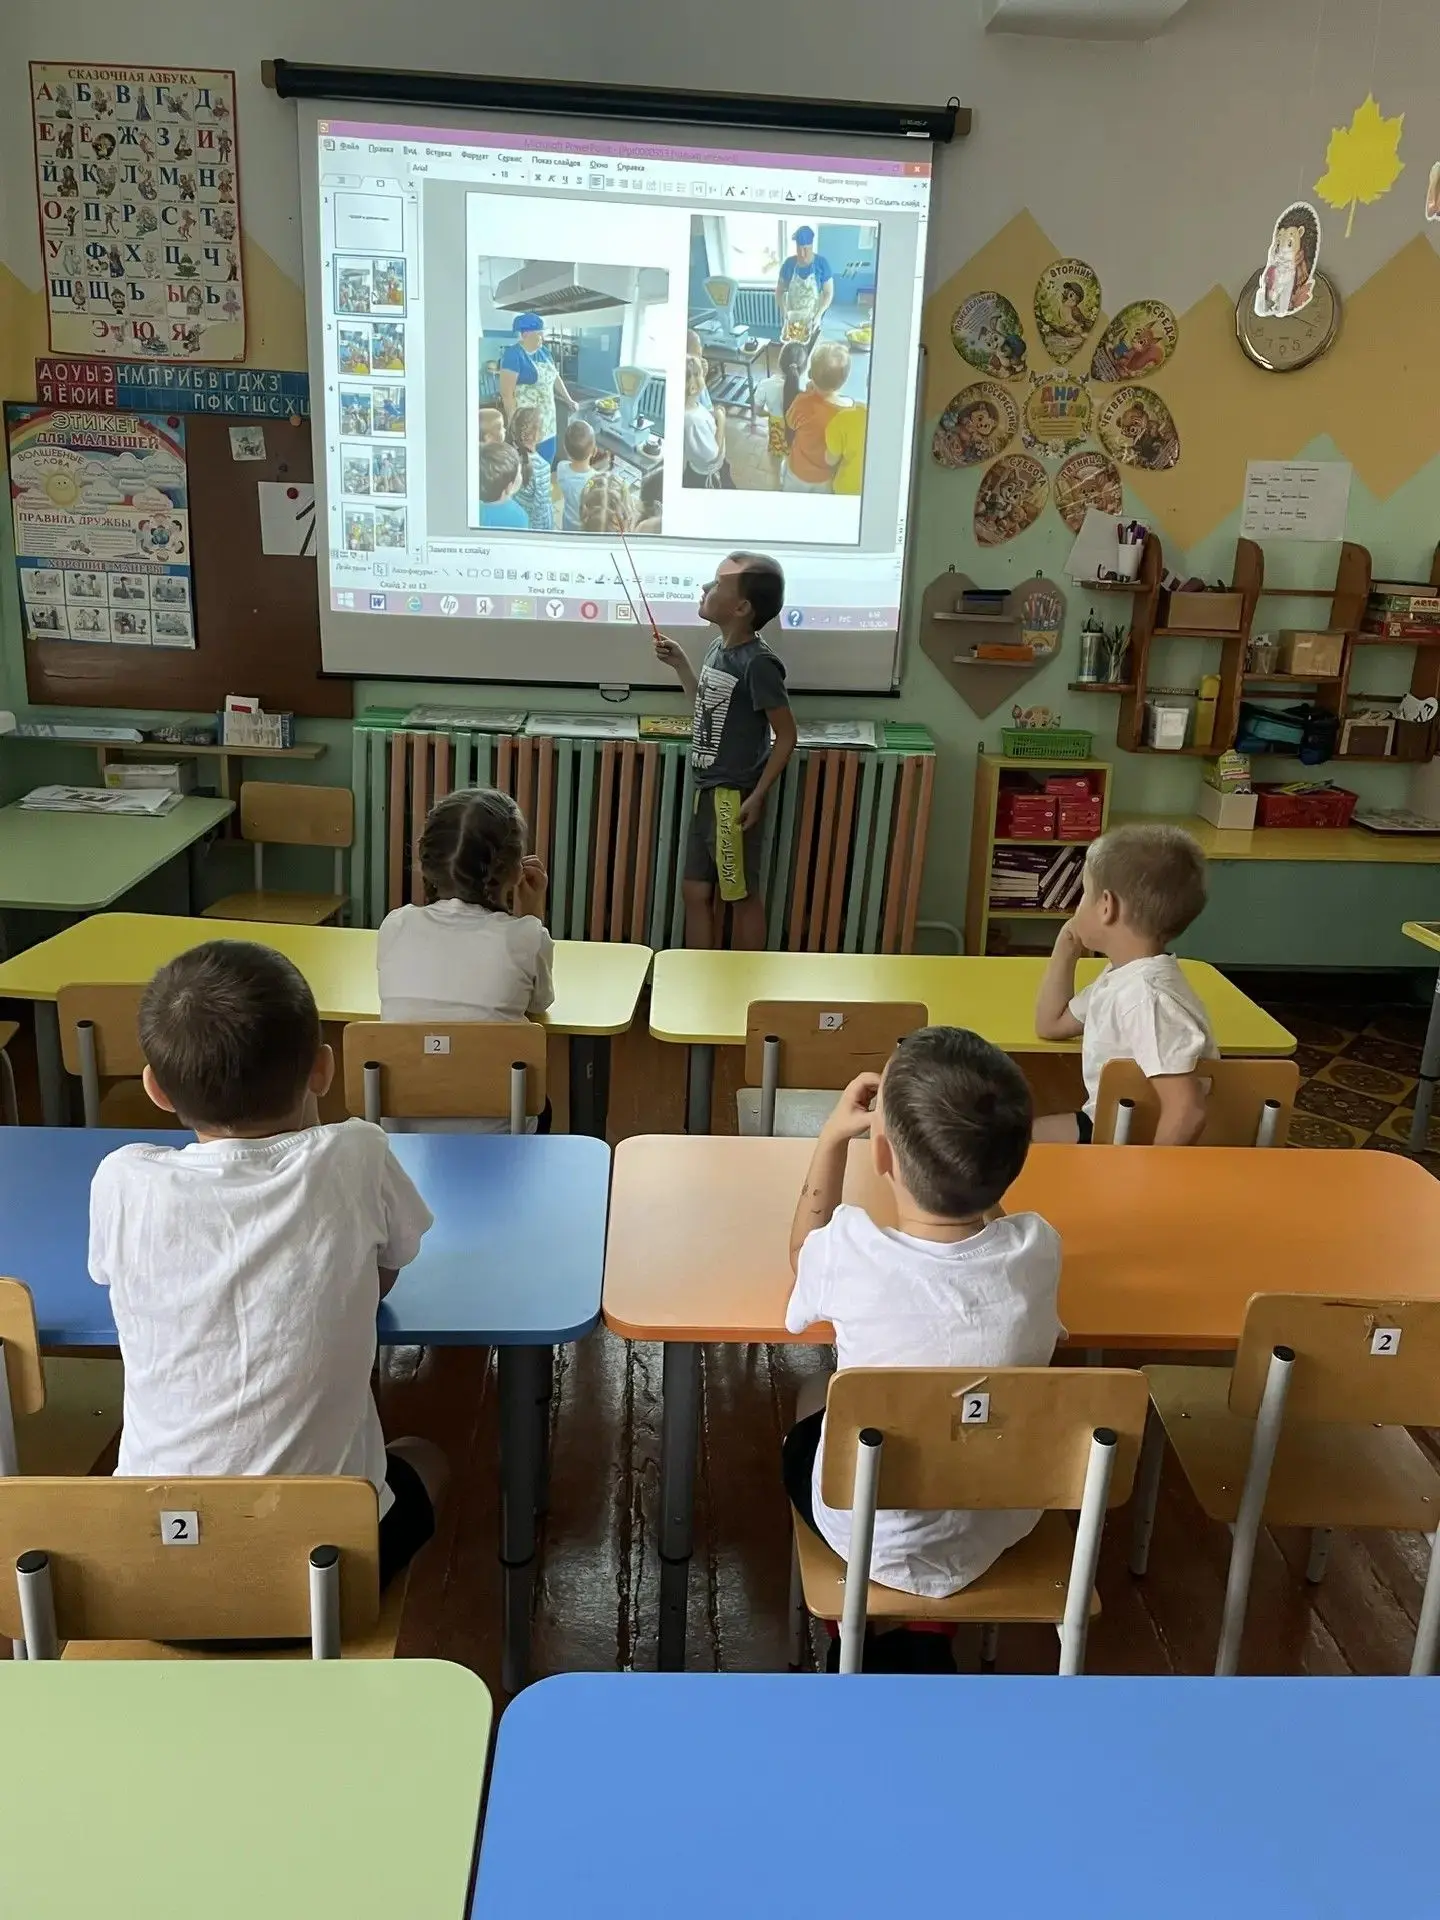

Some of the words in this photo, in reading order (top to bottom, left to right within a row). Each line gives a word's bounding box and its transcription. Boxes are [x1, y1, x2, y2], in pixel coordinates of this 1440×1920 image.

[68, 69, 145, 82] СКАЗОЧНАЯ
[148, 73, 197, 85] АЗБУКА
[37, 84, 53, 101] А
[77, 83, 91, 102] Б
[116, 85, 131, 103] В
[155, 86, 170, 105] Г
[195, 88, 212, 111] Д
[38, 123, 55, 141] Е
[79, 122, 93, 142] Ё
[118, 126, 139, 145] Ж
[157, 127, 170, 146] З
[197, 129, 215, 148] И
[41, 160, 59, 182] Й
[81, 164, 98, 183] К
[120, 165, 137, 184] Л
[159, 167, 179, 185] М
[199, 168, 216, 187] Н
[412, 164, 428, 172] Arial
[44, 201, 62, 219] О
[83, 203, 101, 221] П
[122, 204, 136, 222] Р
[161, 206, 178, 225] С
[200, 208, 216, 227] Т
[47, 240, 63, 258] У
[86, 242, 106, 260] Ф
[125, 244, 142, 262] Х
[165, 245, 181, 265] Ц
[203, 248, 220, 266] Ч
[1050, 265, 1092, 279] ВТОРНИК
[50, 280, 72, 298] Ш
[89, 281, 111, 303] Щ
[126, 283, 145, 301] Ъ
[167, 284, 187, 303] Ы
[205, 285, 221, 304] Ь
[92, 320, 109, 338] Э
[132, 321, 155, 340] Ю
[171, 323, 188, 341] Я
[1153, 306, 1176, 343] СРЕДА
[1101, 389, 1134, 427] ЧЕТВЕРГ
[52, 412, 139, 433] ЭТИКЕТ
[37, 432, 66, 444] ДЛЯ
[71, 433, 160, 449] МАЛЫШЕЙ
[18, 449, 85, 465] ВОЛШЕБНЫЕ
[34, 458, 71, 468] СЛОВА
[1009, 458, 1047, 487] СУББОТА
[19, 513, 75, 525] ПРАВИЛА
[79, 516, 131, 528] ДРУЖБЫ
[1378, 1334, 1392, 1351] 2
[968, 1399, 982, 1418] 2
[171, 1518, 189, 1540] 2
